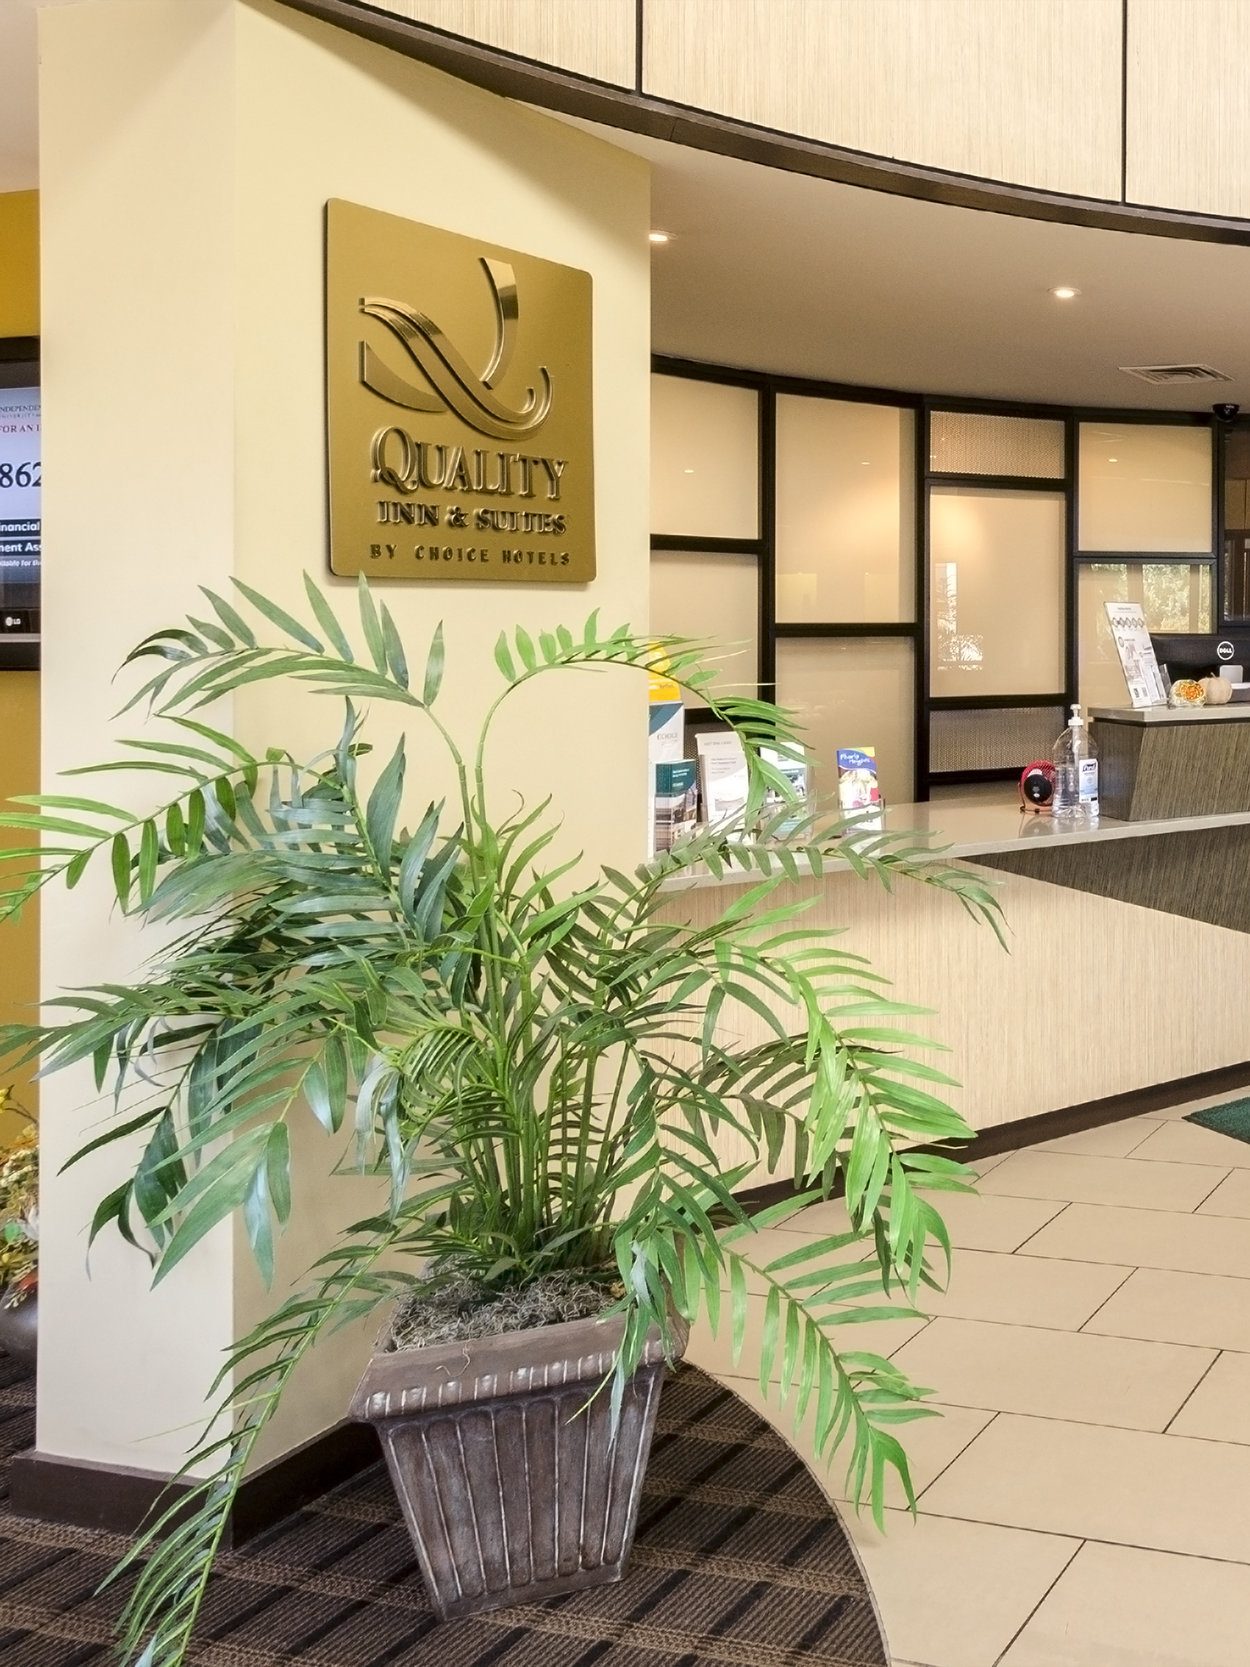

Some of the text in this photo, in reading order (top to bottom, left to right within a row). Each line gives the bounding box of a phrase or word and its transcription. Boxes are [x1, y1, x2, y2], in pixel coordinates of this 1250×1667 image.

[20, 424, 33, 432] AN
[370, 425, 568, 499] QUALITY
[376, 500, 567, 535] INN & SUITES
[370, 544, 570, 565] BY CHOICE HOTELS
